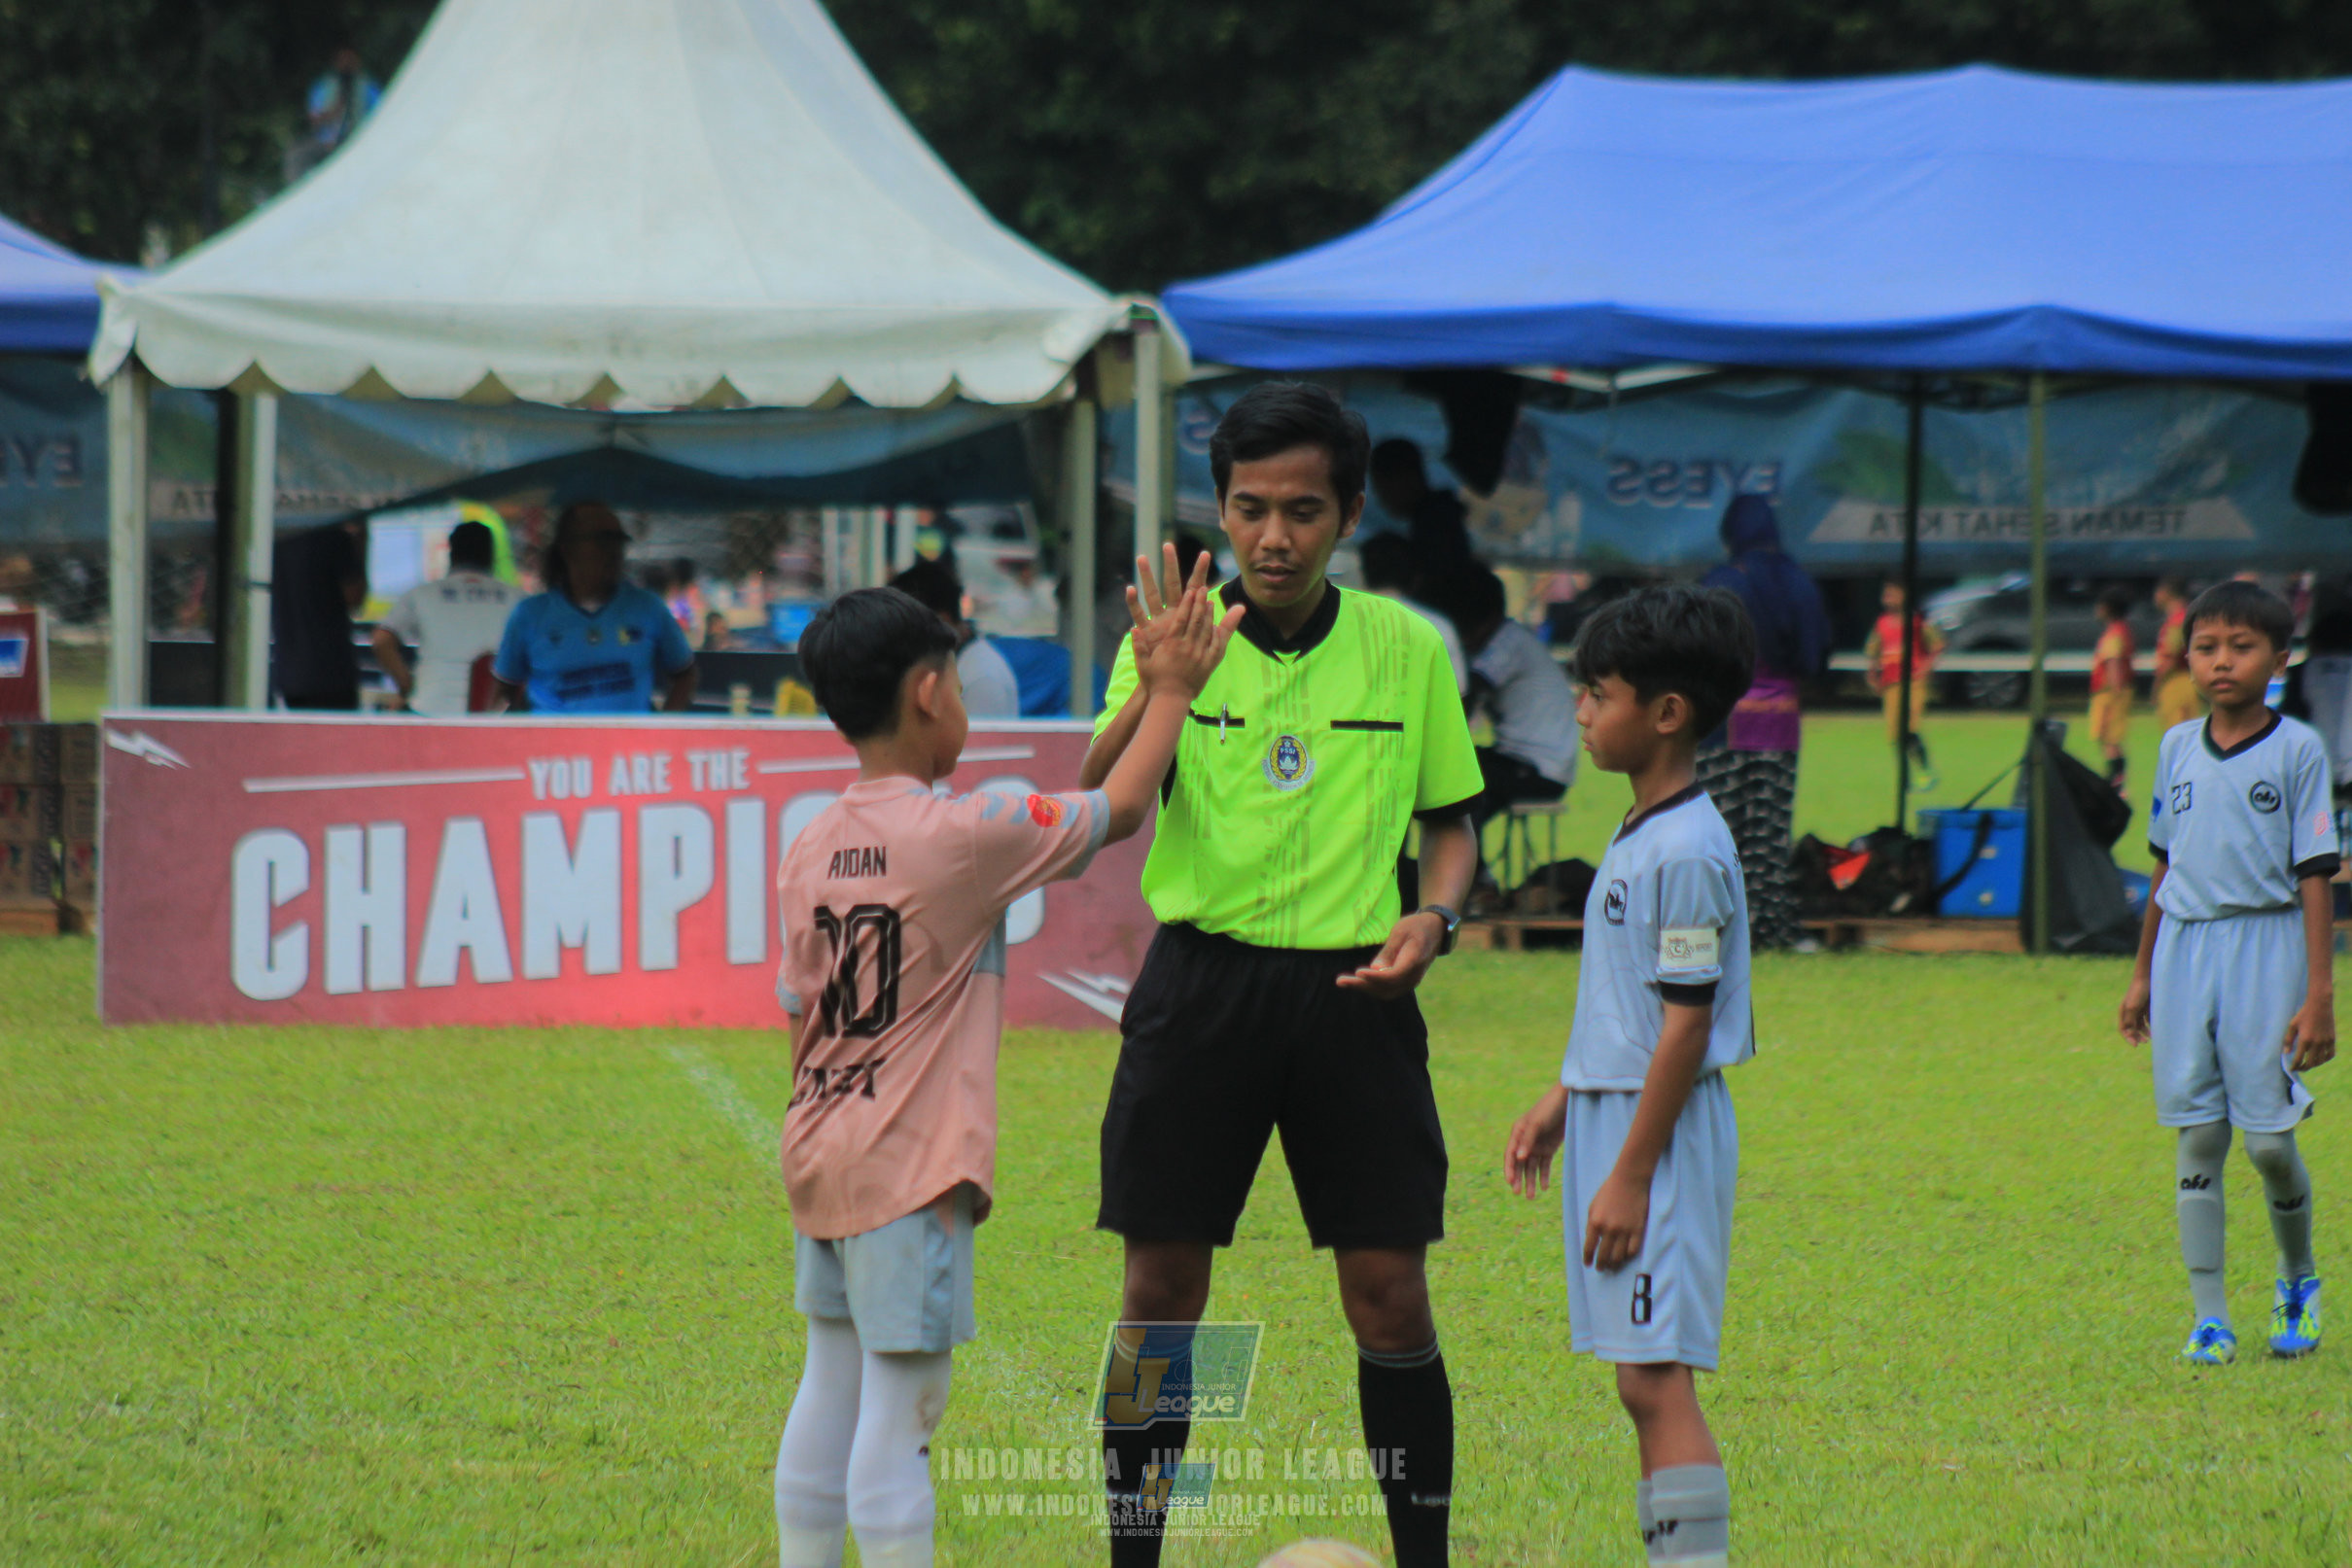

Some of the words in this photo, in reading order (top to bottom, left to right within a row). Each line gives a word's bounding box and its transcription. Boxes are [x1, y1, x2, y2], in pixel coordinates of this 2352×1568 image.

[529, 758, 592, 800] YOU
[609, 754, 670, 795] ARE
[688, 749, 750, 790] THE
[2171, 782, 2193, 815] 23
[827, 845, 887, 879] AIDAN
[813, 903, 901, 1039] 10
[1631, 1273, 1653, 1325] 8
